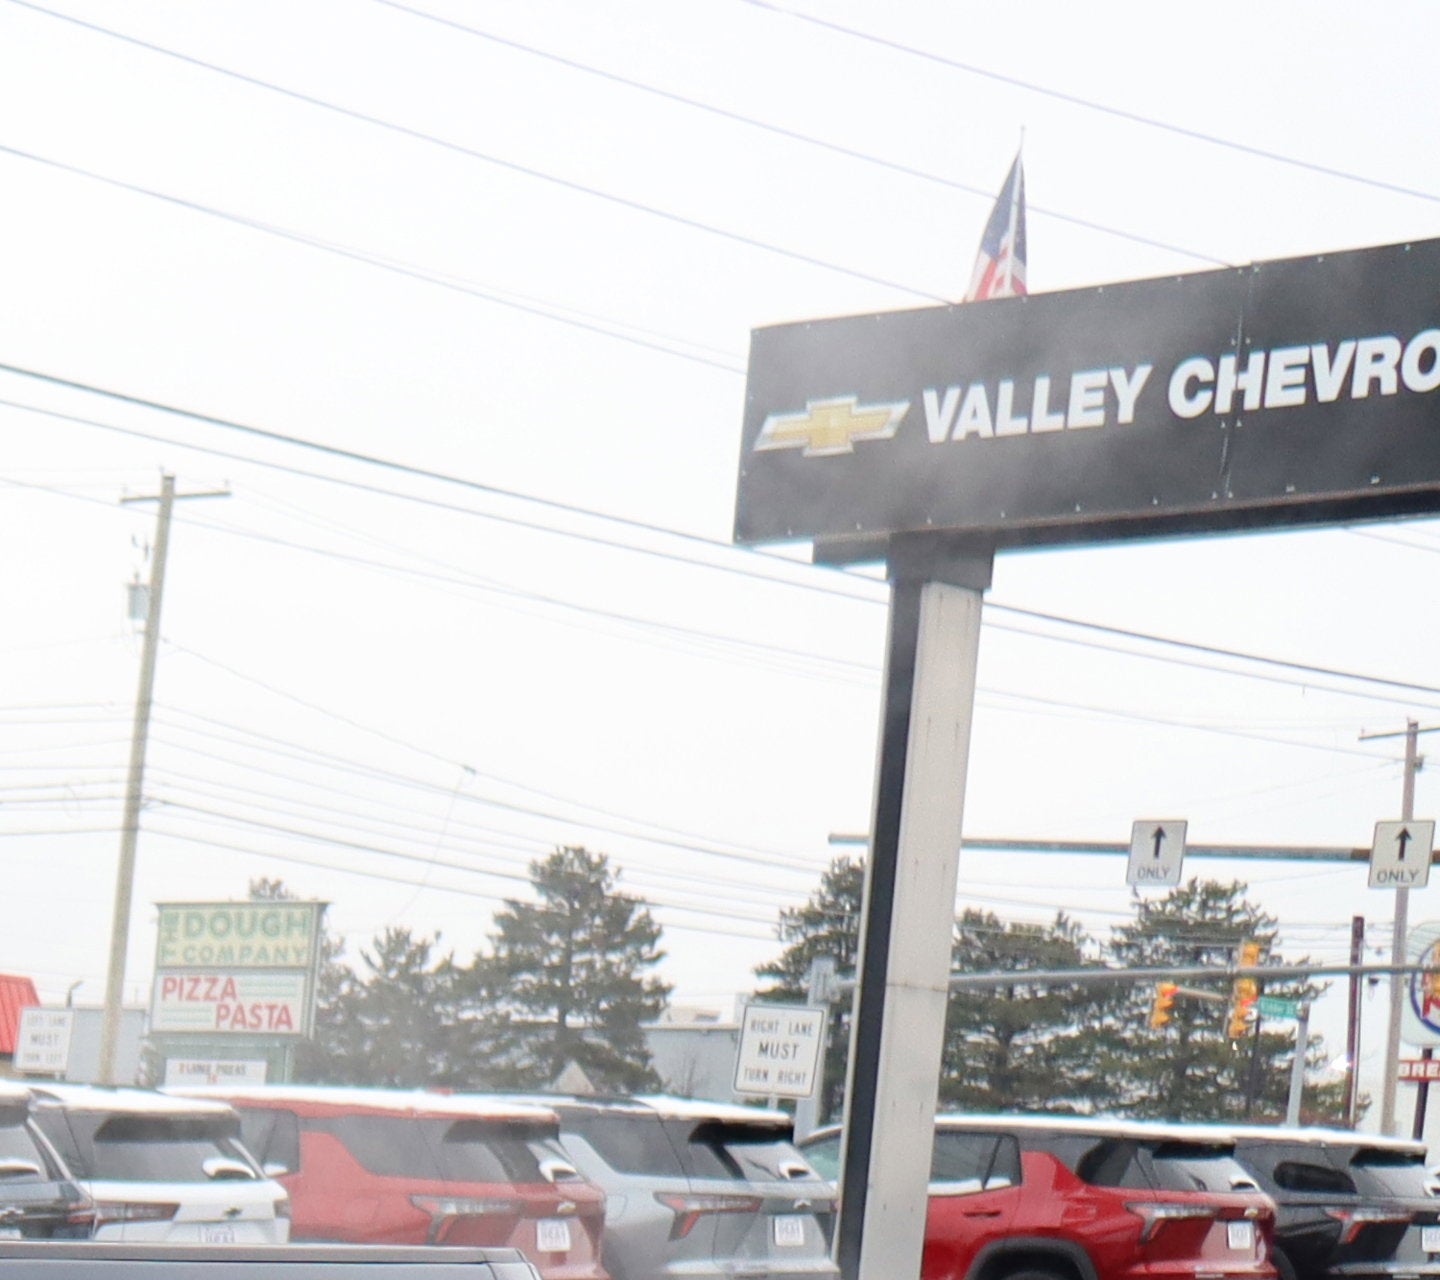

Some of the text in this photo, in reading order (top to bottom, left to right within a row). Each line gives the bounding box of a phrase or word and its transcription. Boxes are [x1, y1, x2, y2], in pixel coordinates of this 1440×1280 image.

[922, 329, 1440, 444] VALLEY CHEVRO
[1137, 866, 1171, 881] ONLY
[1376, 869, 1420, 884] ONLY
[185, 910, 311, 939] DOUGH
[183, 944, 308, 963] COMPANY
[161, 977, 238, 1001] PIZZA
[215, 1003, 294, 1031] PASTA
[750, 1019, 813, 1037] RIGHT LANE
[758, 1041, 800, 1061] MUST
[743, 1066, 807, 1086] TURN RIGHT
